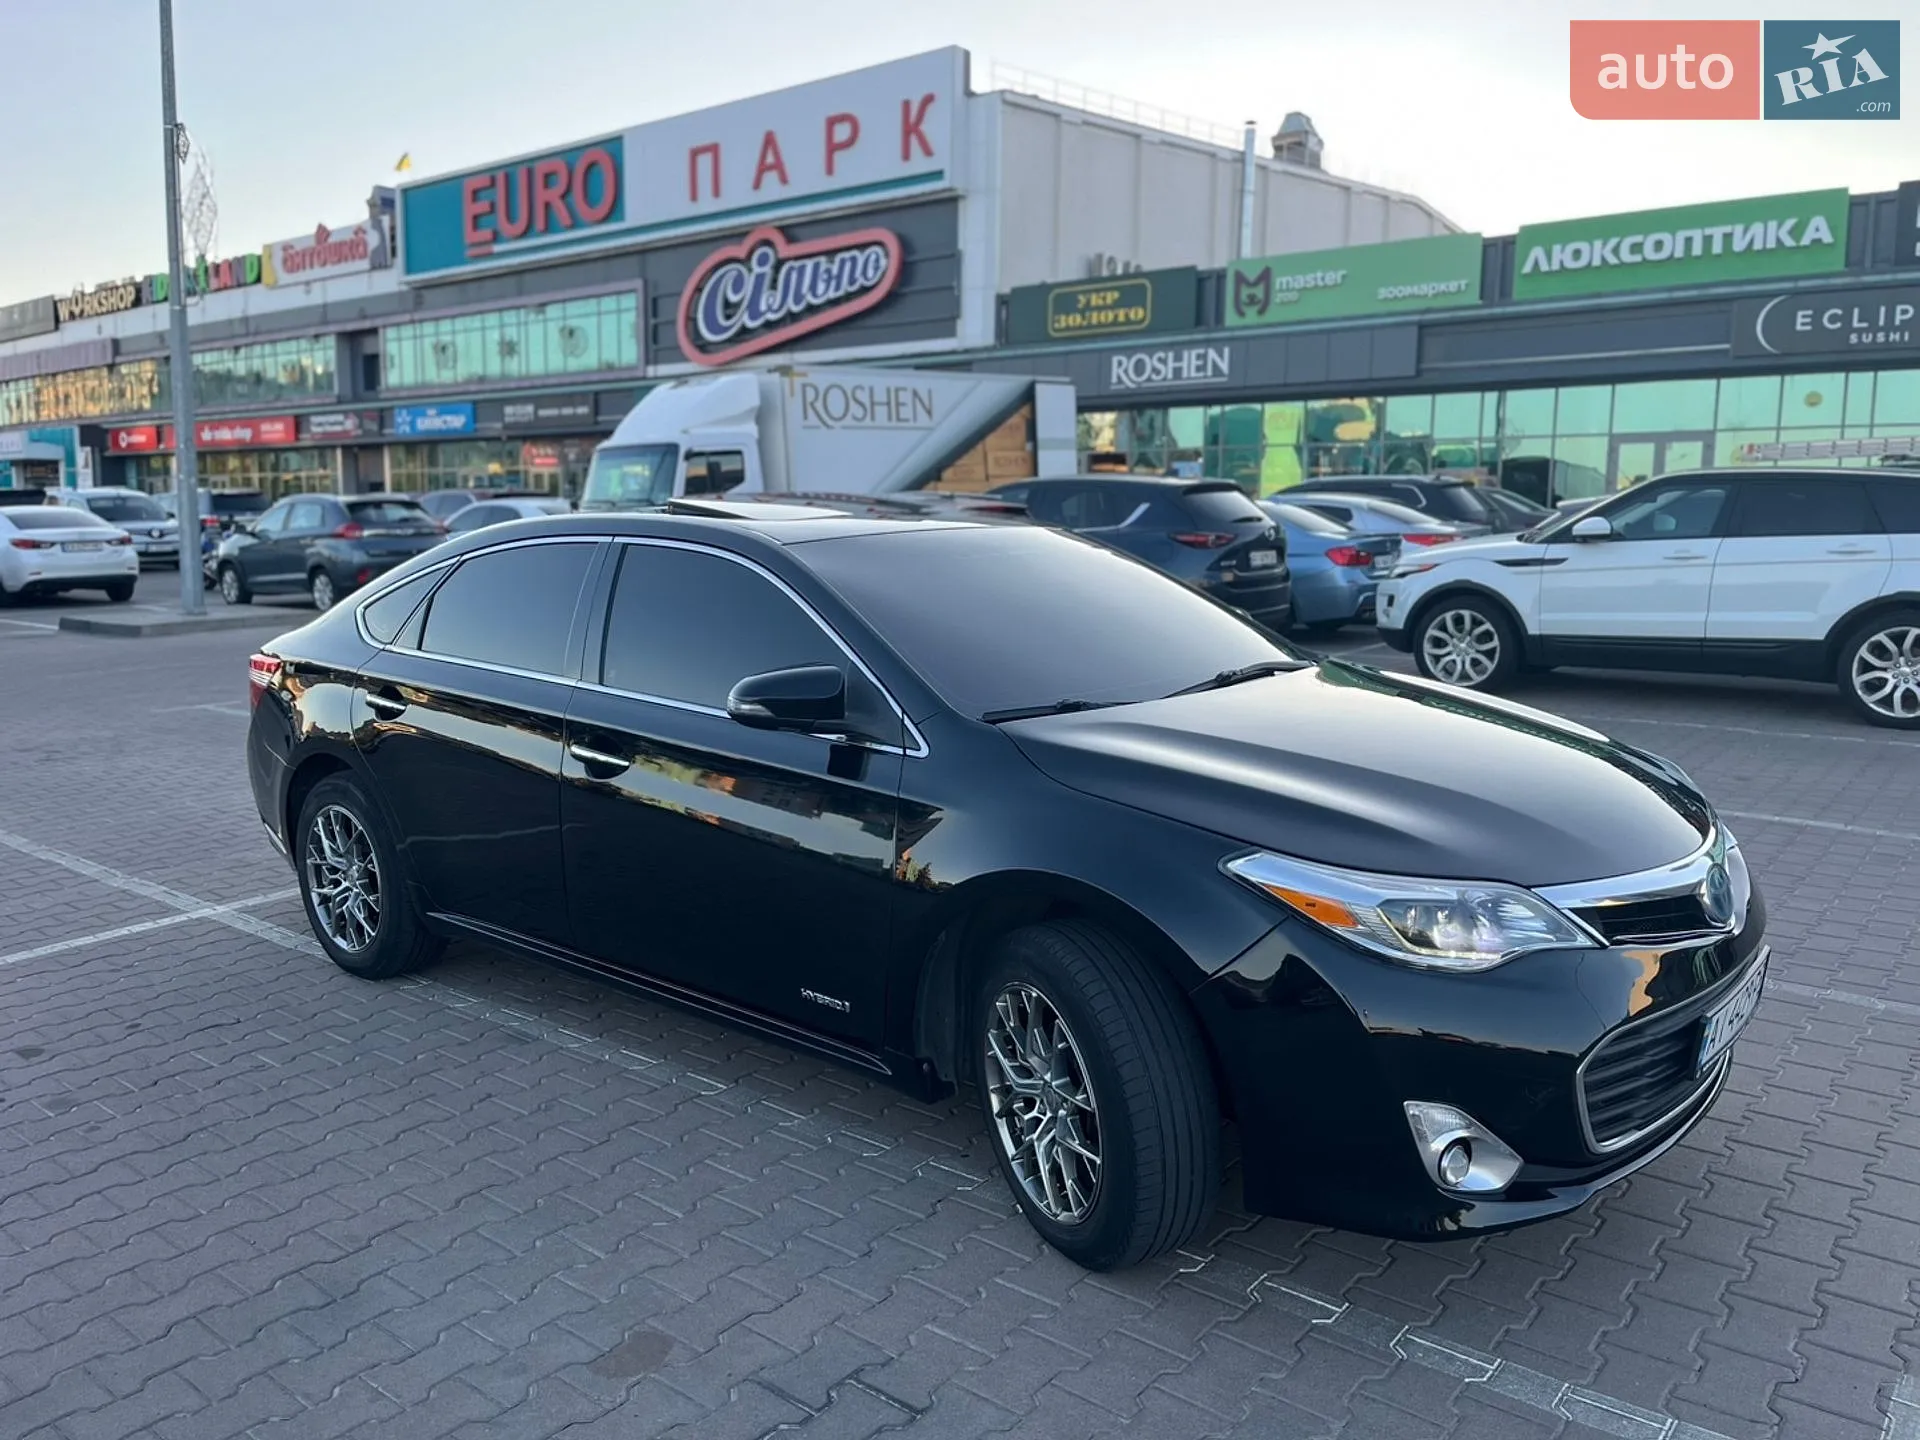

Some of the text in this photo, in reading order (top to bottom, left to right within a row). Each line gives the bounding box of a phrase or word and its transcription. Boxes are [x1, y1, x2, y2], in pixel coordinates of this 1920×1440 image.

[463, 93, 935, 246] EURO ПАРК
[1521, 215, 1834, 274] ЛЮКСОПТИКА
[698, 246, 888, 342] Сільпо
[1275, 269, 1347, 290] master
[57, 285, 136, 321] WORKSHOP
[1054, 307, 1145, 329] ЗОЛОТО
[1077, 290, 1119, 309] УКР
[1849, 331, 1910, 344] SUSHI
[1110, 347, 1230, 388] ROSHEN
[801, 383, 933, 430] ROSHEN
